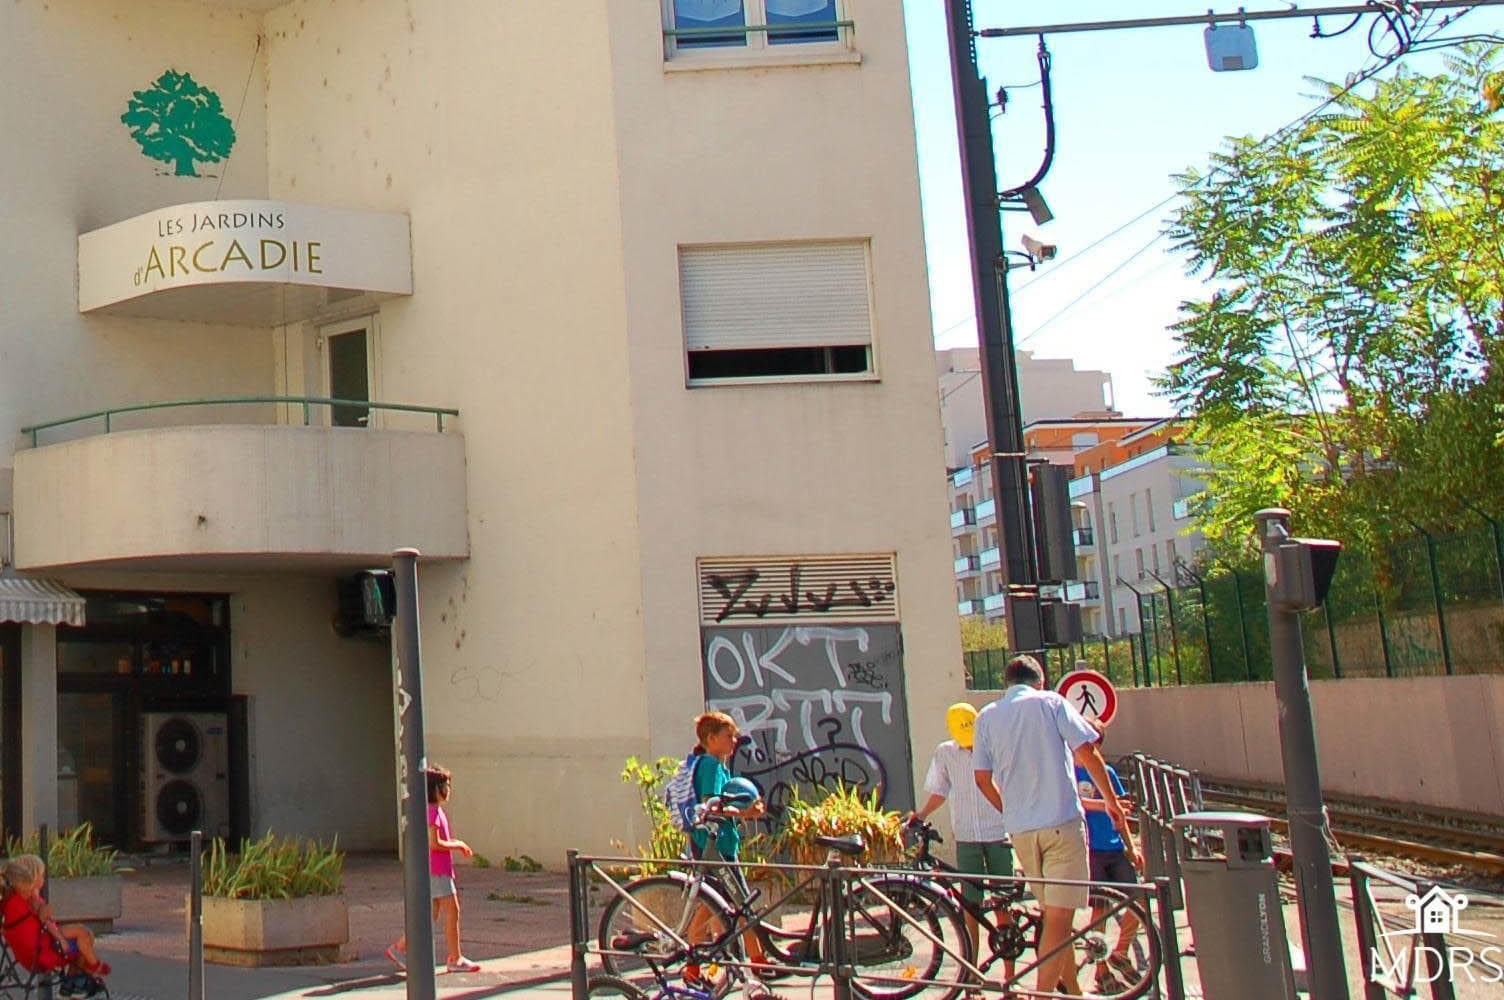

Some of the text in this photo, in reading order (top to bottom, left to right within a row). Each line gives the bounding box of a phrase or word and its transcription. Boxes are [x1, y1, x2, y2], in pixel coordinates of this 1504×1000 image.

[158, 213, 285, 238] LES JARDINS
[133, 239, 323, 287] d'ARCADIE
